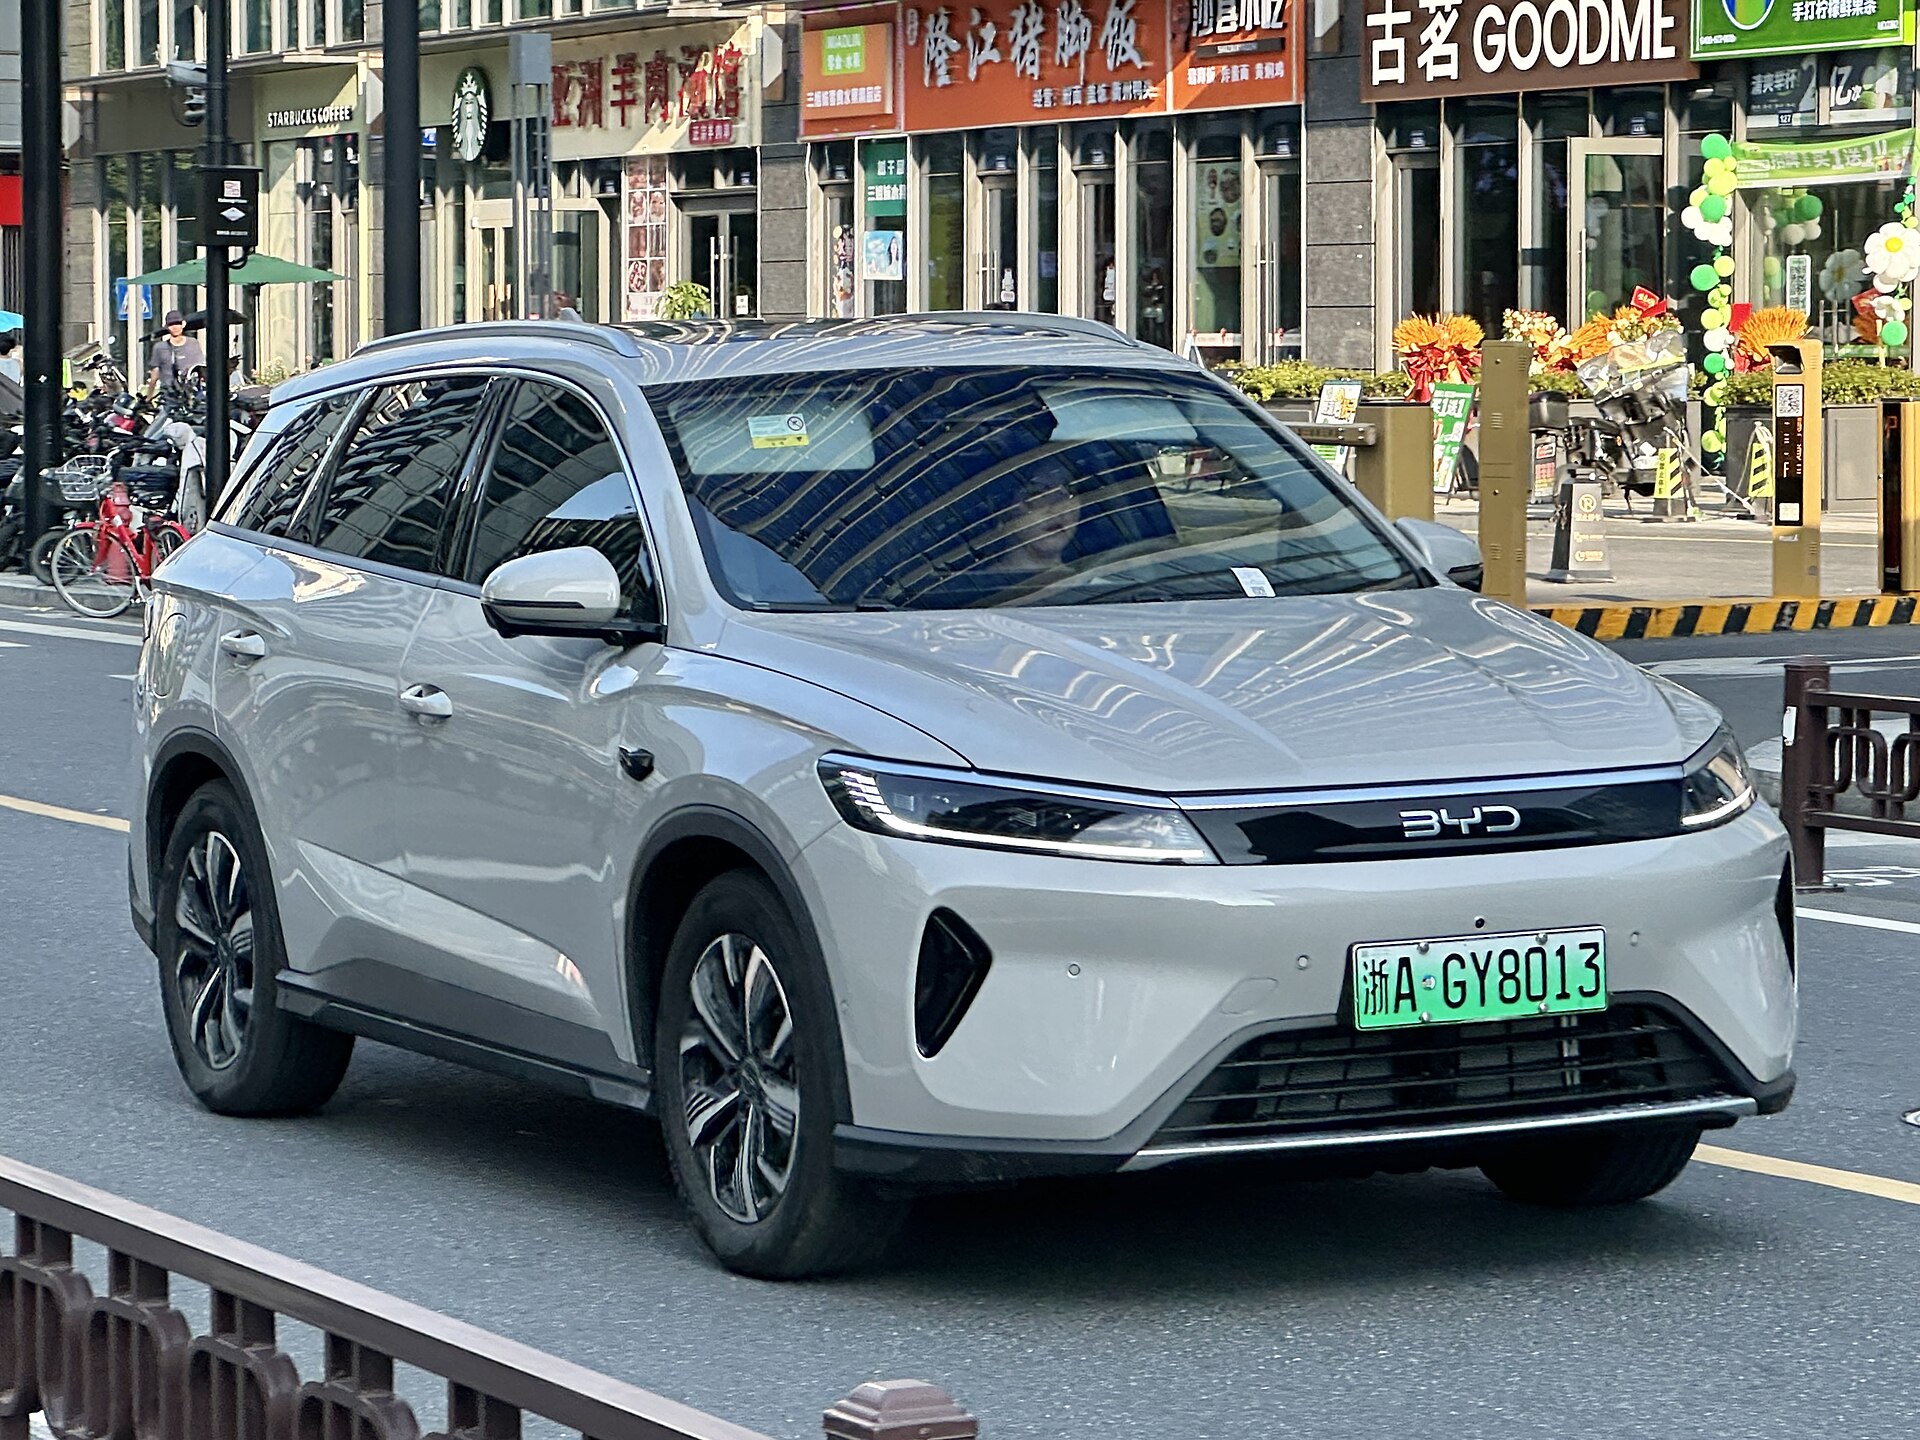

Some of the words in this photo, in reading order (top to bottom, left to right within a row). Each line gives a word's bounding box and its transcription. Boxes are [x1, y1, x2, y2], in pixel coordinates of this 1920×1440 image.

[1366, 0, 1463, 85] 古茗
[1473, 0, 1676, 73] GOODME
[267, 108, 317, 128] STARBUCKS
[318, 105, 350, 124] COFFEE
[1779, 114, 1792, 124] 127
[1400, 805, 1521, 838] BYD
[1363, 956, 1417, 1016] 浙A
[1442, 942, 1601, 1009] GY8013
